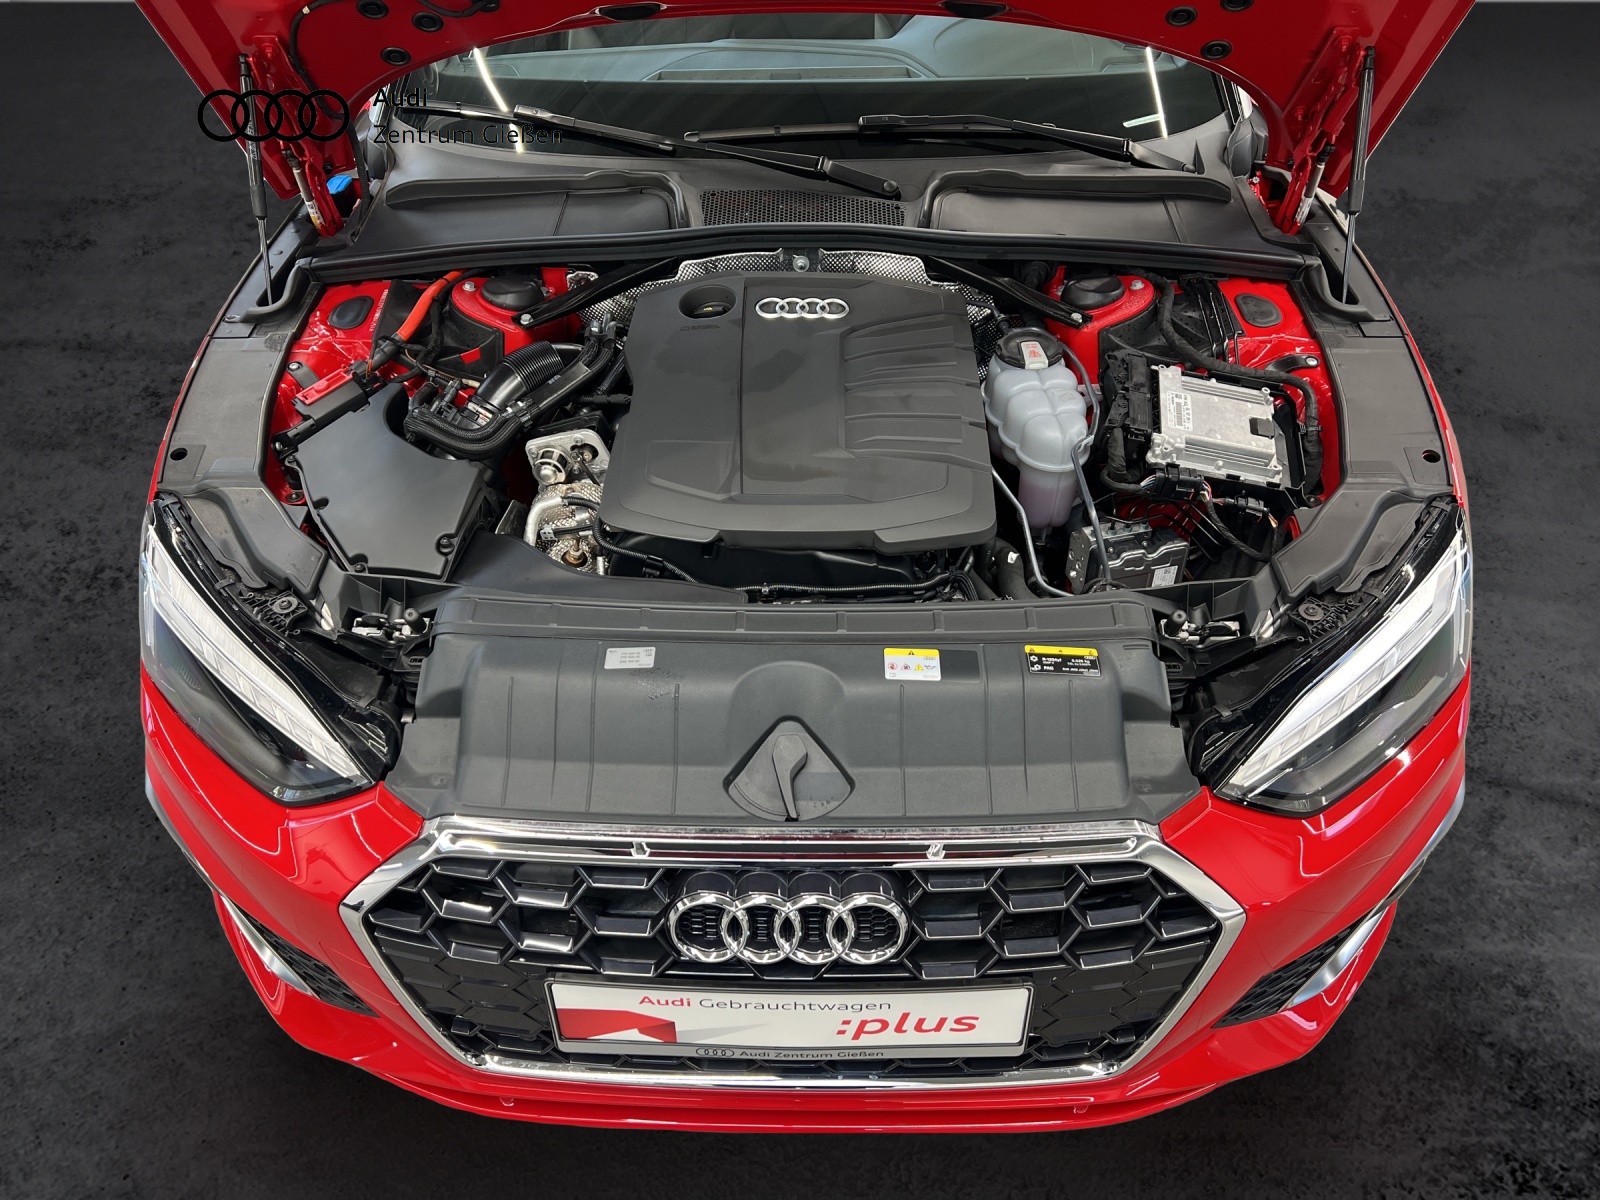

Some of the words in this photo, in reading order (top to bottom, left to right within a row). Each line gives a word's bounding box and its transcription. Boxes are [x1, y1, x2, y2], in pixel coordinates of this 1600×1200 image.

[638, 996, 692, 1007] Audi
[699, 998, 892, 1013] Gebrauchtwagen
[836, 1012, 980, 1041] :plus
[740, 1050, 771, 1058] Audi
[774, 1050, 833, 1058] Zentrum
